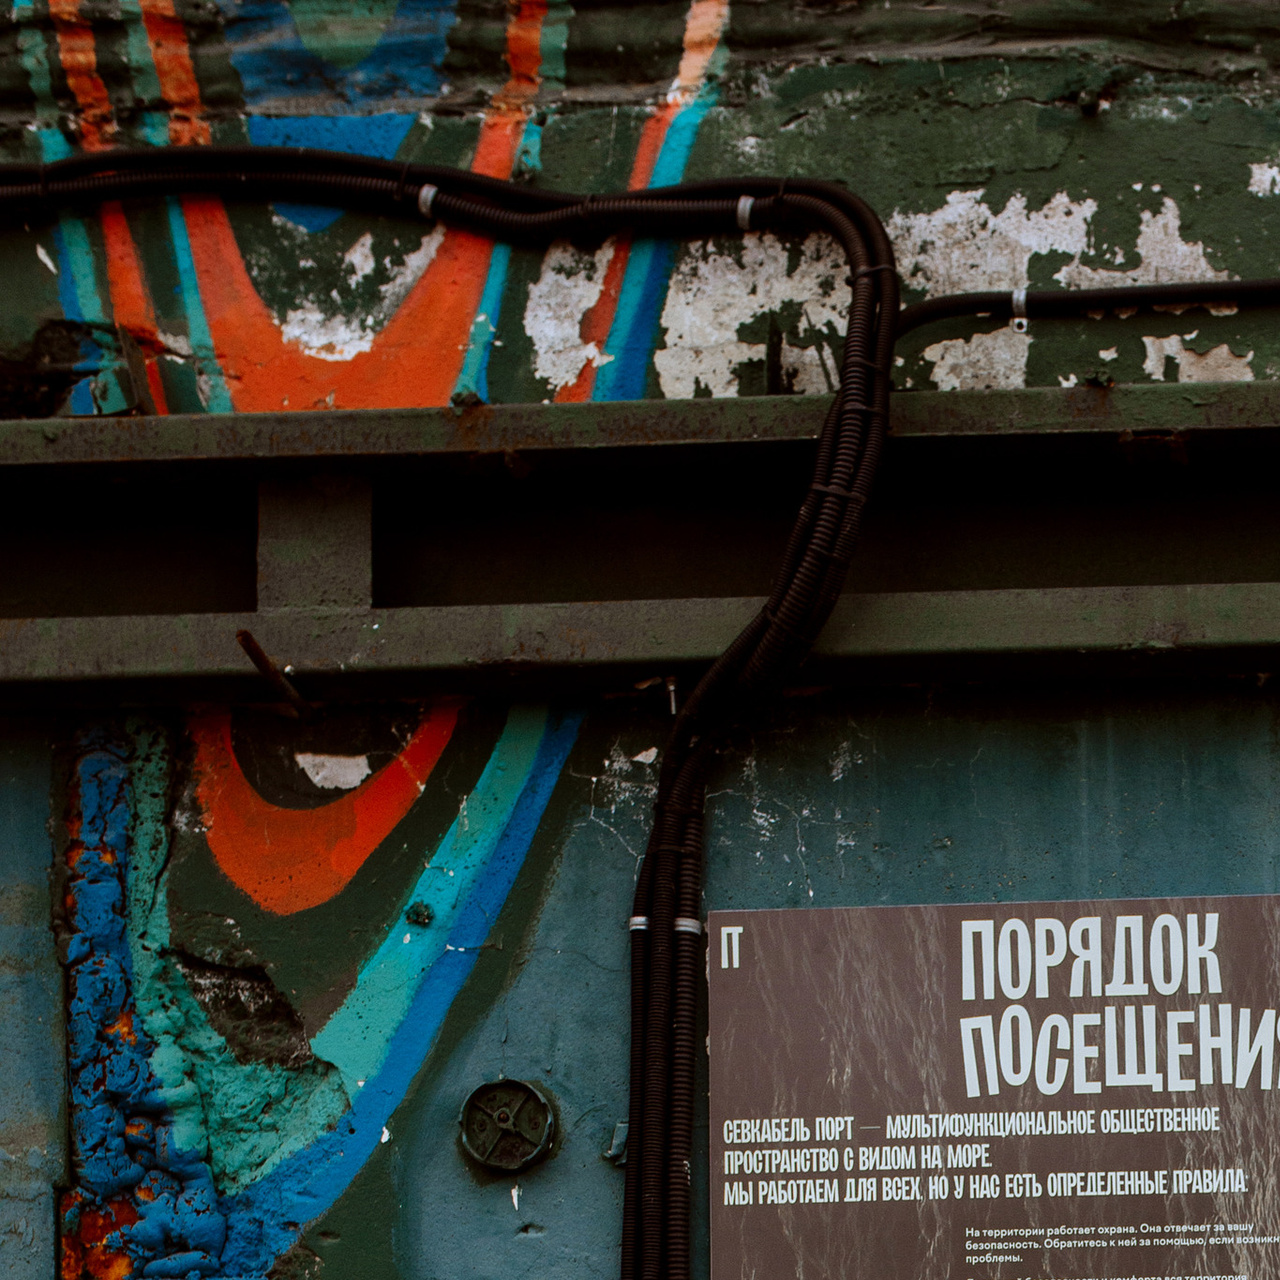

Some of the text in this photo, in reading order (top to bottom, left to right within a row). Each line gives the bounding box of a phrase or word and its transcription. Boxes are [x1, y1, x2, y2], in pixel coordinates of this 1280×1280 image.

[961, 913, 1222, 1000] ПОРЯДОК
[723, 1118, 811, 1144] СЕВКАБЕЛЬ
[815, 1116, 854, 1141] ПОРТ
[886, 1110, 1096, 1139] МУЛЬТИФУНКЦИОНАЛЬНОЕ
[1100, 1106, 1220, 1134] ОБЩЕСТВЕННОЕ
[724, 1143, 993, 1175] ПРОСТРАНСТВО С ВИДОМ НА МОРЕ.
[724, 1168, 1249, 1206] МЫ РАБОТАЕМ ДЛЯ ВСЕХ, НО У НАС ЕСТЬ ОПРЕДЕЛЕННЫЕ ПРАВИЛА:
[965, 1223, 1254, 1239] На территории работает охрана. Она отвечает за вашу
[965, 1239, 1041, 1250] безопасность.
[1043, 1237, 1107, 1250] Обратитесь
[1117, 1236, 1136, 1247] ней
[1139, 1238, 1150, 1246] за
[1153, 1237, 1206, 1247] помощью,
[1208, 1236, 1234, 1245] если
[965, 1252, 1023, 1266] проблемы.
